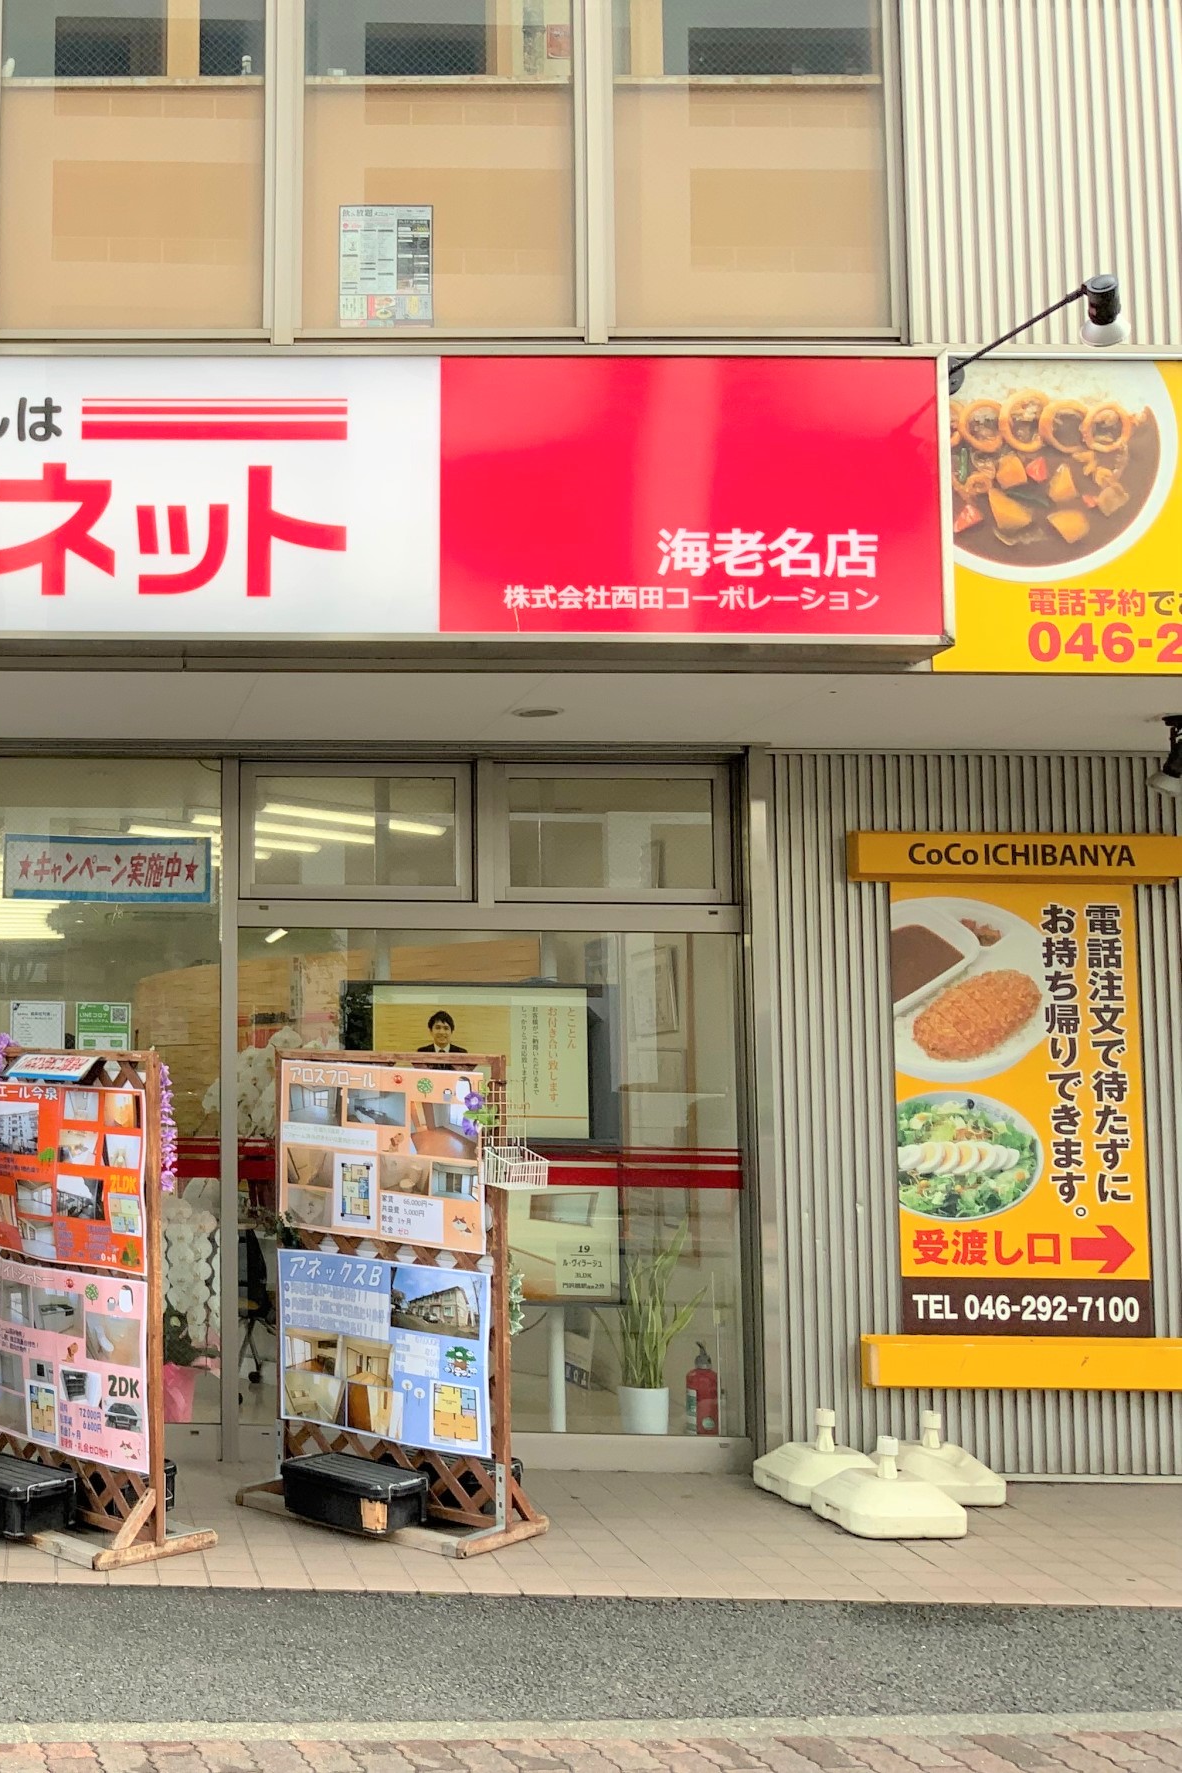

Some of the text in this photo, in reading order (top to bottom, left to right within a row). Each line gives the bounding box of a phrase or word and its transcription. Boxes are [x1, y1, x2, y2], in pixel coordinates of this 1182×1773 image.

[657, 528, 879, 578] 海老名店
[503, 585, 880, 611] 株式会社西田コーポレーション
[908, 842, 1136, 867] CoCo ICHIBANYA
[567, 1007, 577, 1050] とことん
[1041, 904, 1087, 1218] お持ち帰りできます。
[1085, 904, 1132, 1203] 電話注文で待たずに
[578, 1245, 591, 1253] 19
[913, 1228, 1061, 1266] 受渡し口
[289, 1256, 383, 1287] アネックスB
[913, 1295, 1140, 1323] TEL 046-292-7100
[108, 1374, 140, 1399] 2DK
